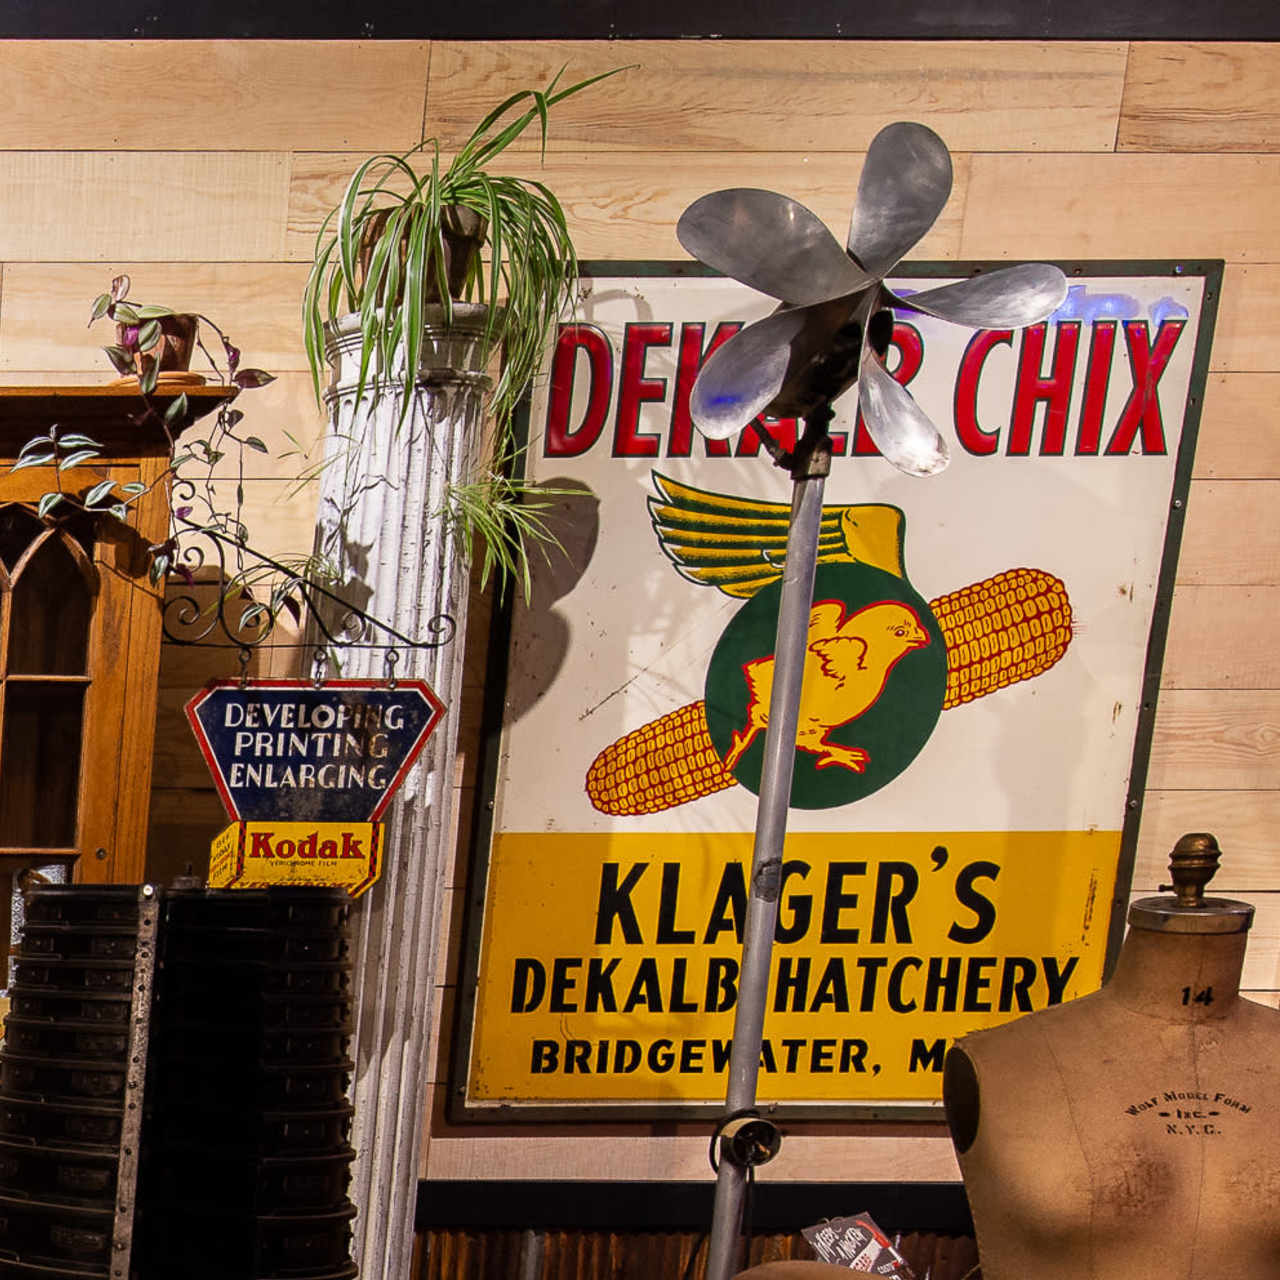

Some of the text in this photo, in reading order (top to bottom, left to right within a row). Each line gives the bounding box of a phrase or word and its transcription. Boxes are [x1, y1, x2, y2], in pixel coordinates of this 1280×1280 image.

[953, 319, 1188, 457] CHIX
[224, 703, 405, 730] DEVELOPING
[234, 732, 389, 758] PRINTING
[229, 763, 387, 789] ENLARGING
[249, 831, 365, 859] Kodak
[594, 845, 1002, 945] KLAGER'S
[510, 957, 1080, 1013] DEKALB HATCHERY
[1181, 987, 1214, 1006] 14
[1125, 1091, 1252, 1116] WOLF MODEL FORM
[1166, 1123, 1222, 1135] N.Y.C.
